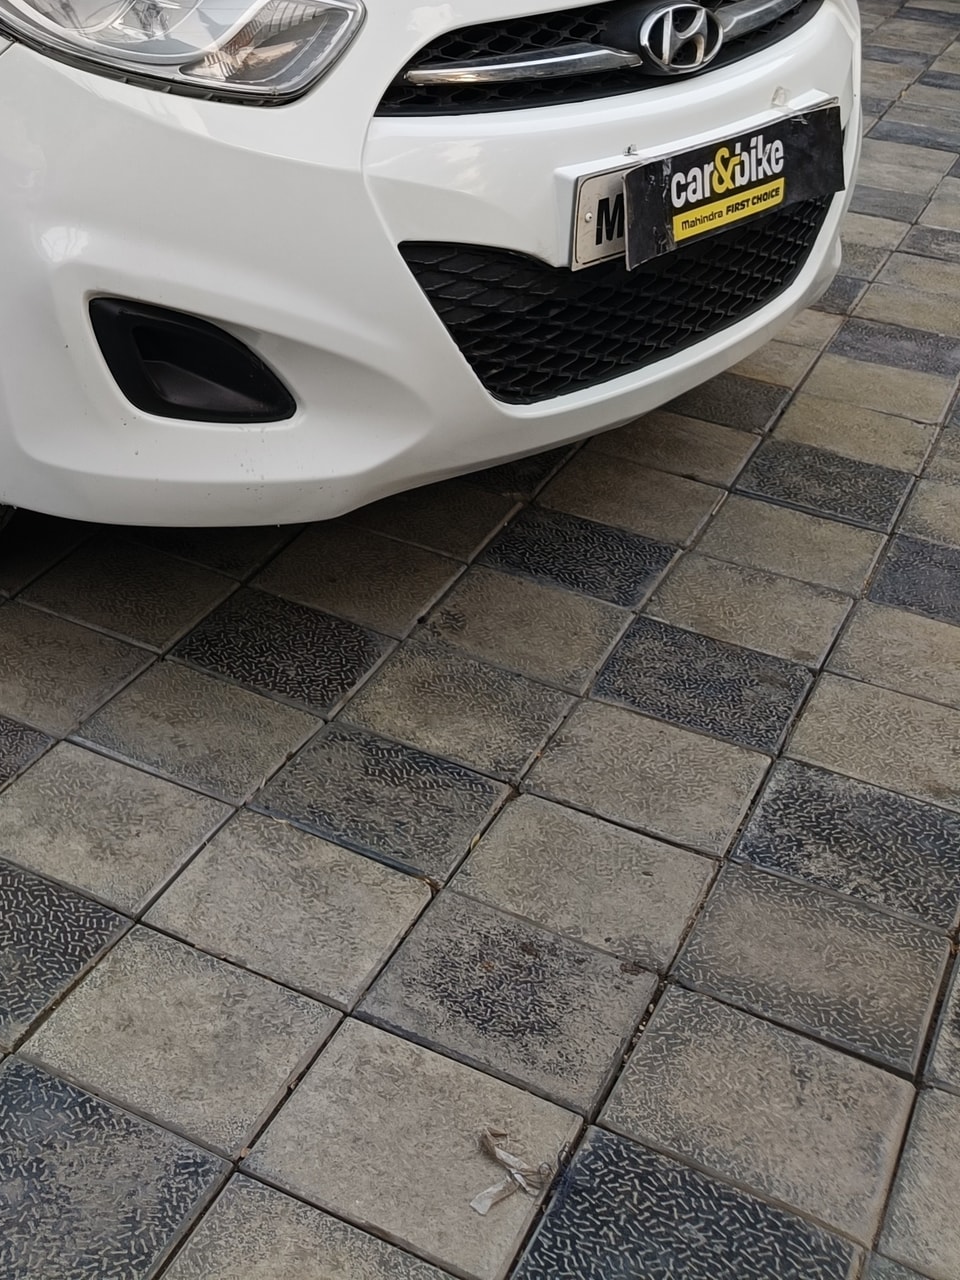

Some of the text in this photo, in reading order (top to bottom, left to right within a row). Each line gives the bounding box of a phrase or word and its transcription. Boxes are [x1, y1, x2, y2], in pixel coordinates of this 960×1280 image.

[671, 134, 785, 209] car&bike
[681, 186, 781, 231] Mahindra FIRST CHOICE
